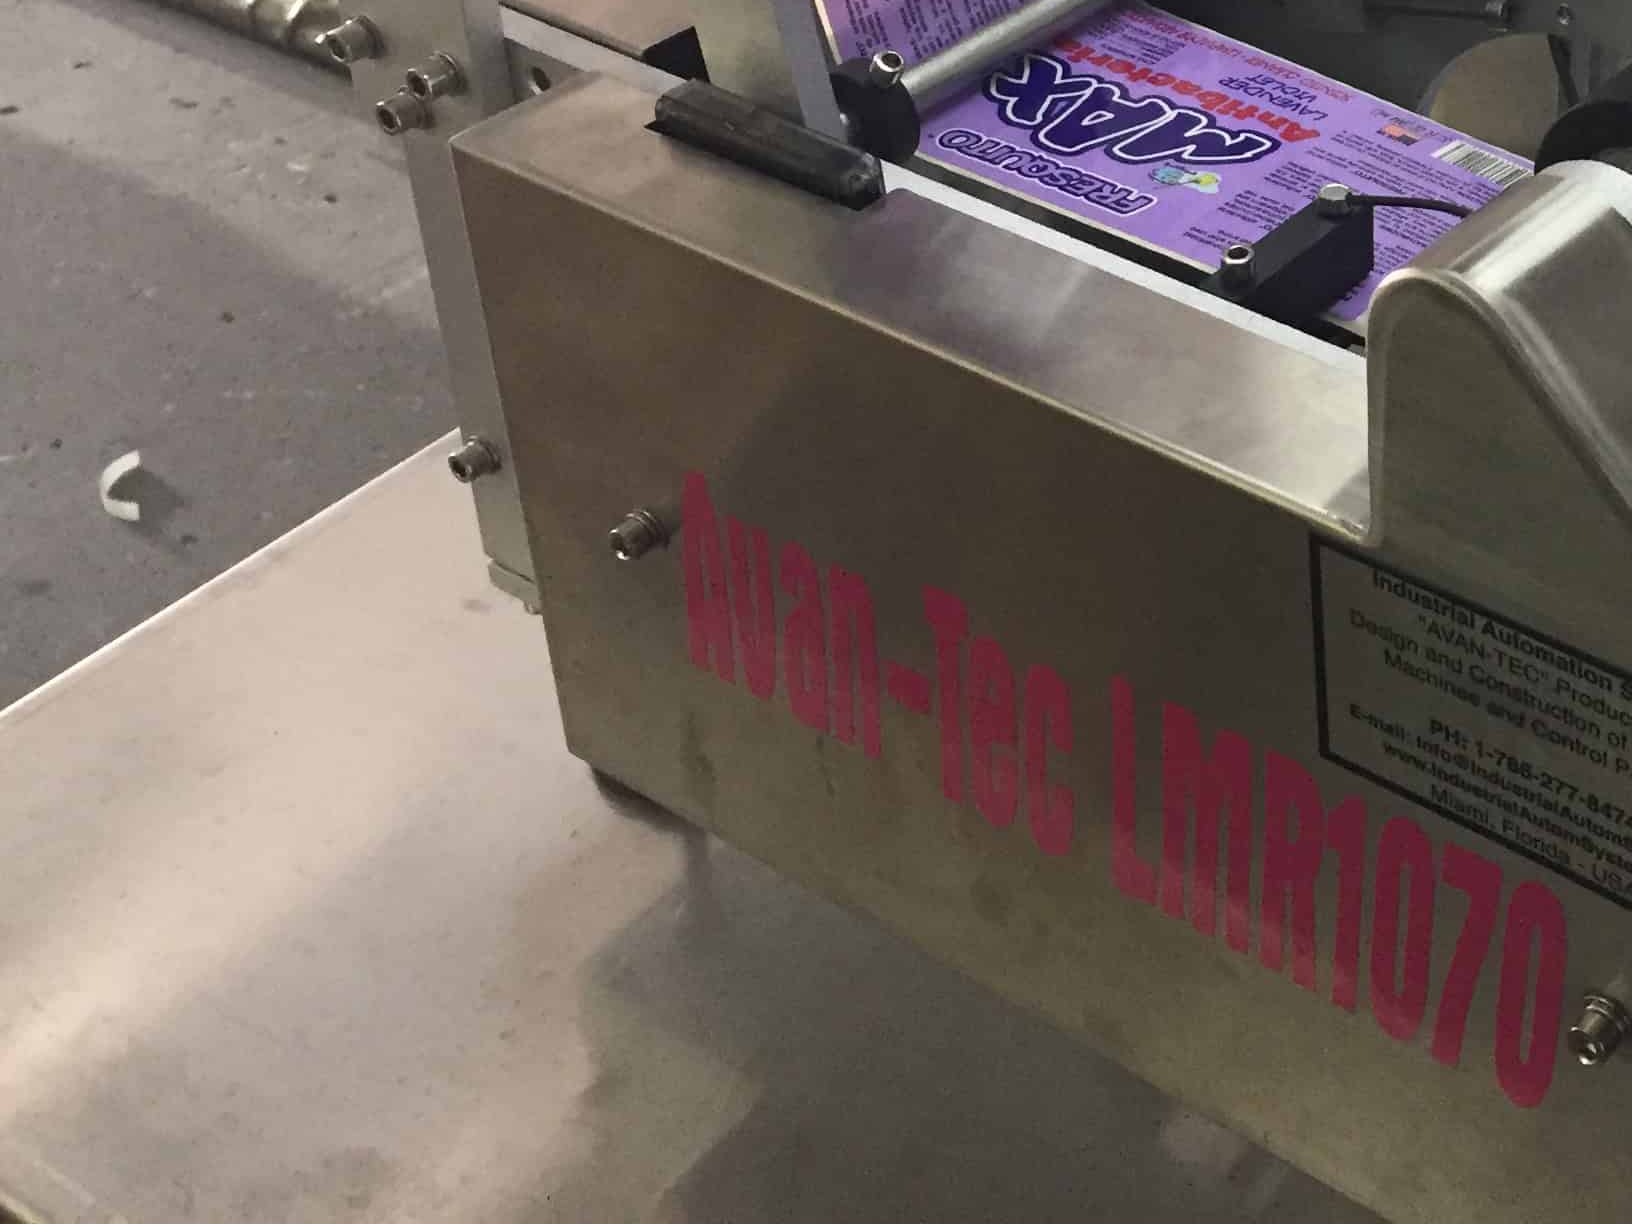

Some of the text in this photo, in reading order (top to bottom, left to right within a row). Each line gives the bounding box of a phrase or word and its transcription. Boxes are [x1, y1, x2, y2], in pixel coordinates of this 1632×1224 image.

[984, 53, 1282, 165] MAX
[1219, 76, 1328, 121] LAVENDER
[1246, 73, 1318, 103] VIOLET
[936, 128, 1158, 216] FRESQUITO
[1350, 606, 1418, 658] Design
[1426, 642, 1461, 675] and
[1469, 662, 1600, 740] Construction
[1608, 727, 1631, 752] of
[1373, 569, 1474, 631] Industrial
[1481, 618, 1612, 693] Automation
[1384, 648, 1479, 707] Machines
[1486, 697, 1521, 728] and
[1531, 717, 1606, 767] Control
[681, 470, 1568, 1108] Avan-Tec LMR1070
[1502, 817, 1569, 867] Florida
